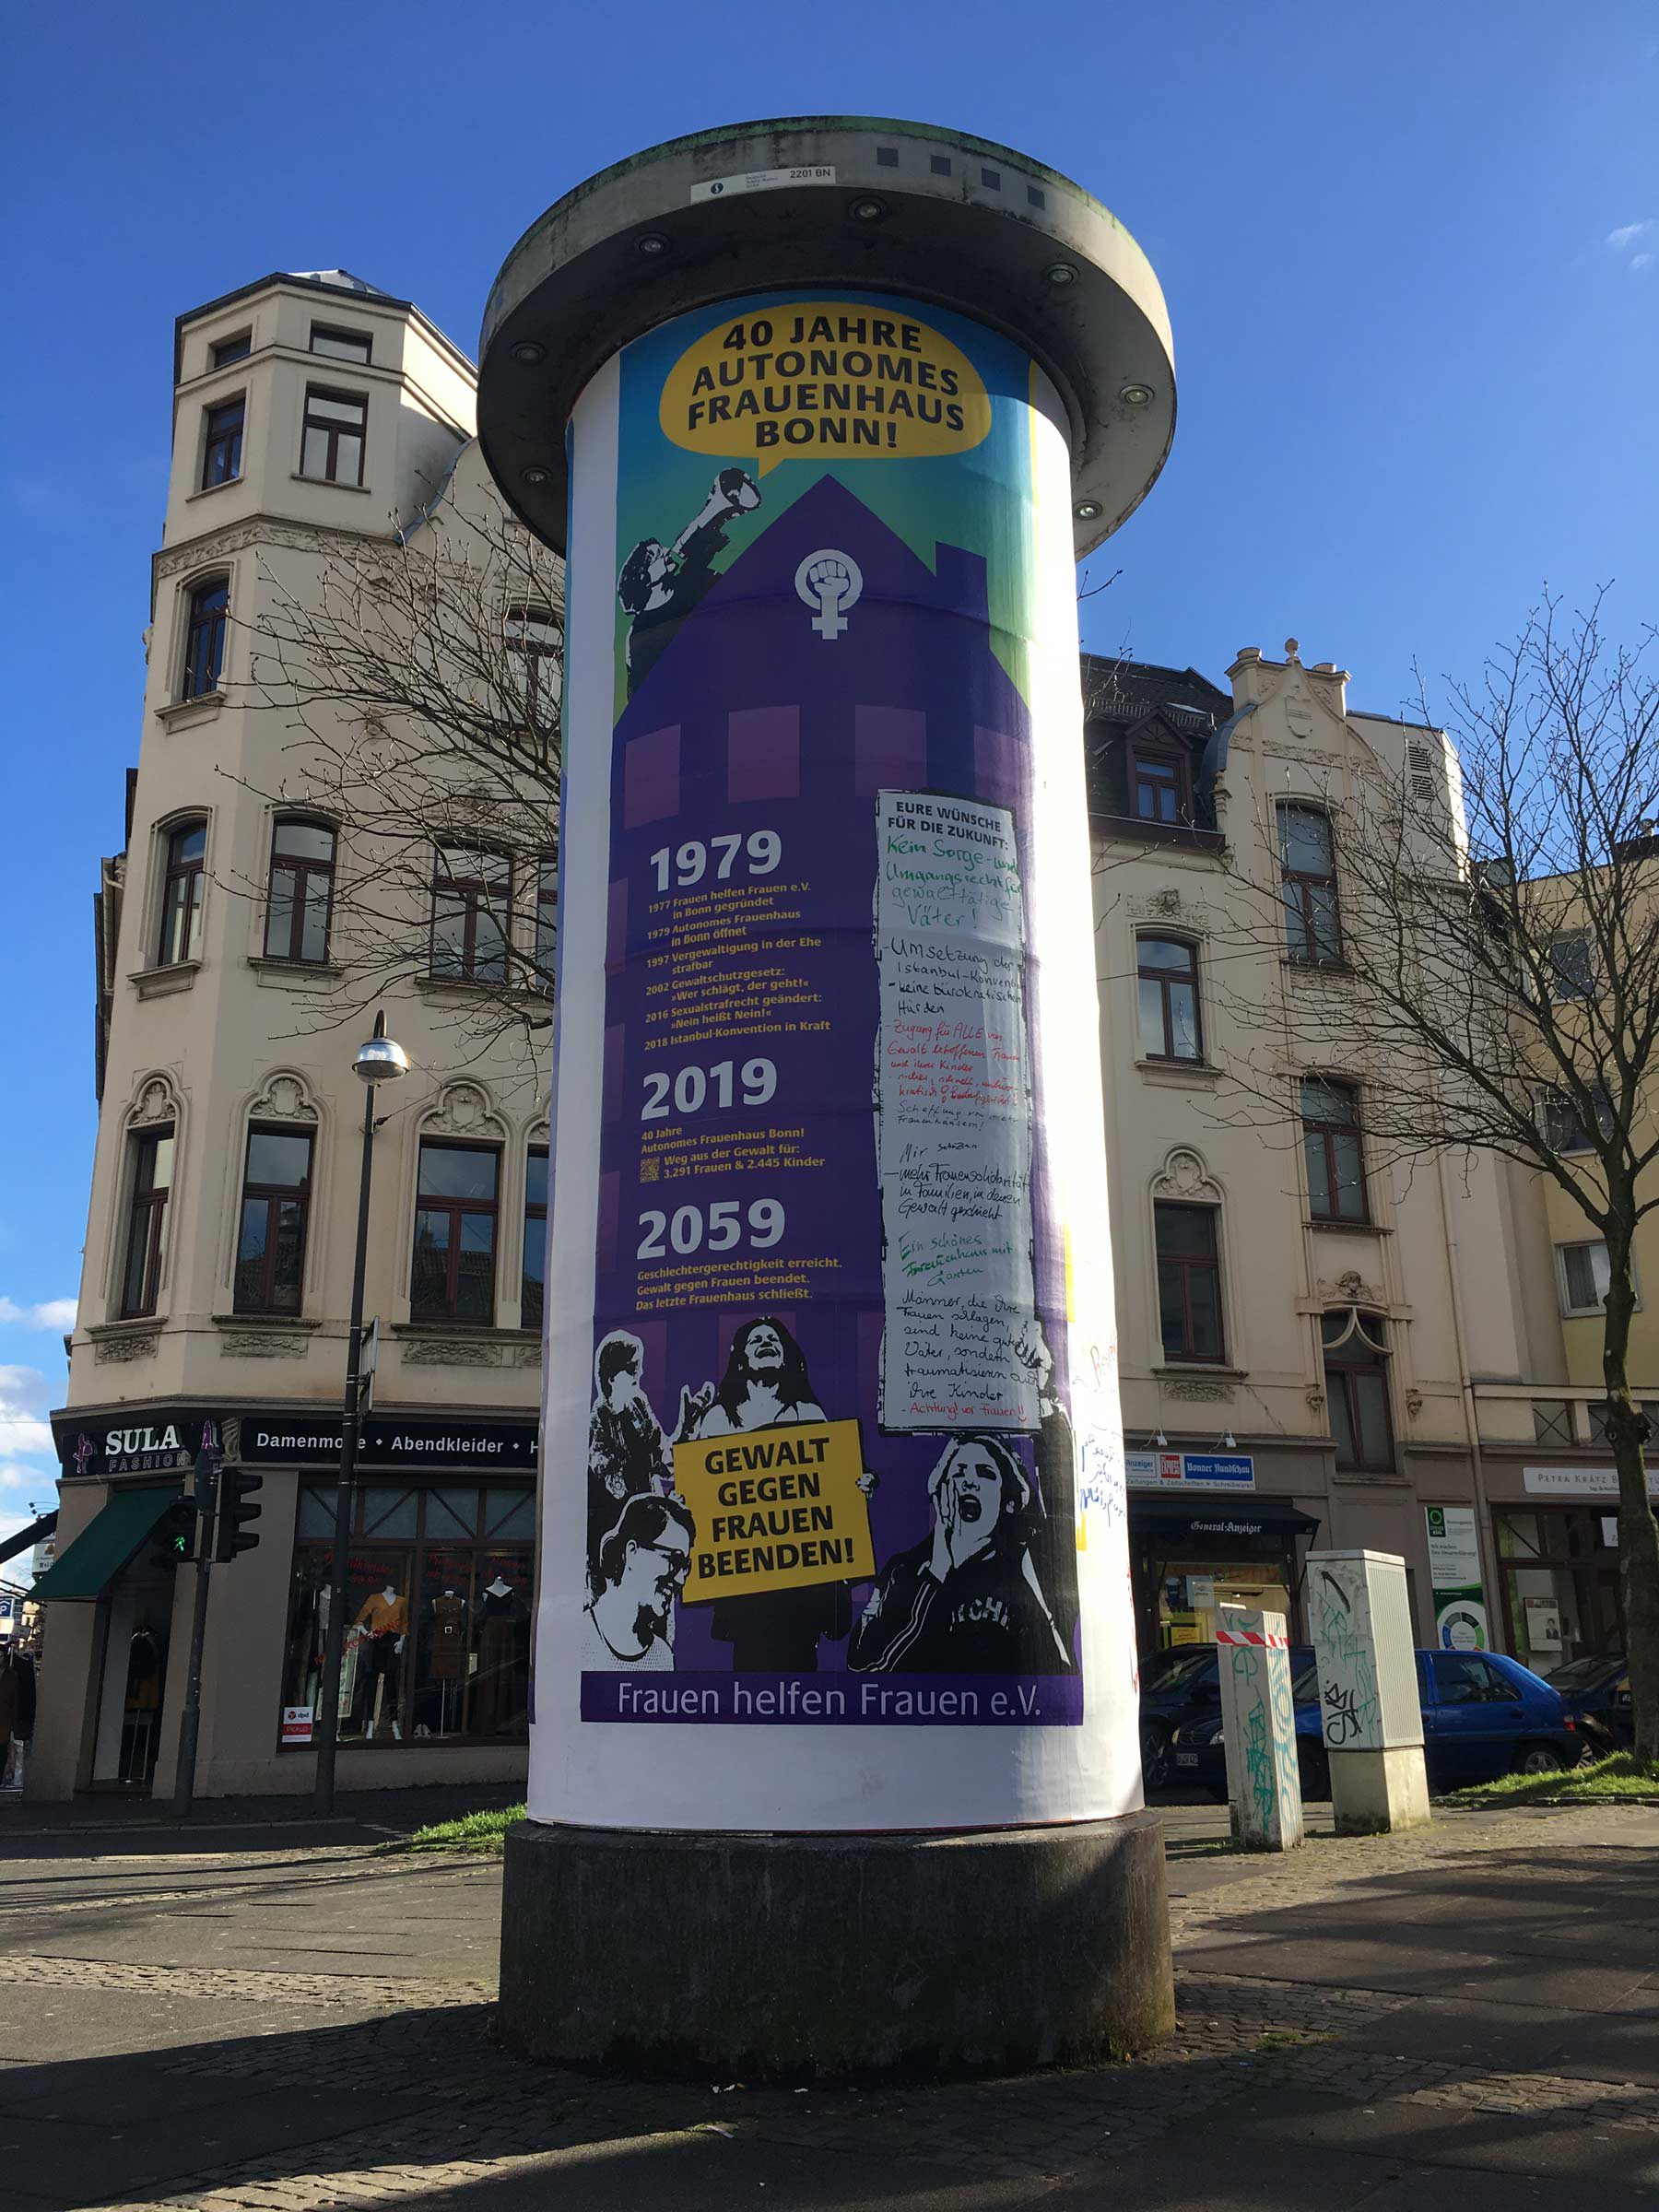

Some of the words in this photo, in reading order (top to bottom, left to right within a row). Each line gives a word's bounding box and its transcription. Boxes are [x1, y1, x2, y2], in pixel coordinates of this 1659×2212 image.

[790, 170, 812, 178] 2201
[816, 169, 830, 177] BN
[724, 320, 773, 350] 40
[790, 316, 922, 353] JAHRE
[691, 349, 959, 395] AUTONOMES
[688, 383, 964, 431] FRAUENHAUS
[756, 418, 897, 448] BONN!
[896, 802, 932, 817] EURE
[937, 806, 1001, 831] WÜNSCHE
[888, 816, 916, 830] FÜR
[922, 822, 944, 834] DIE
[947, 826, 1008, 850] ZUKUNFT:
[888, 834, 926, 854] Kein
[650, 830, 782, 892] 1979
[649, 900, 670, 913] 1977
[673, 895, 707, 907] Frauen
[711, 888, 745, 900] helfen
[748, 882, 786, 895] Frauen
[791, 882, 811, 892] e.V.
[673, 911, 682, 919] in
[686, 905, 711, 916] Bonn
[714, 897, 774, 913] gegründet
[648, 927, 670, 940] 1979
[673, 918, 731, 934] Autonomes
[735, 911, 801, 924] Frauenhaus
[671, 937, 680, 947] in
[684, 931, 710, 945] Bonn
[713, 926, 747, 939] öffnet
[647, 956, 669, 968] 1997
[673, 942, 758, 962] Vergewaltigung
[761, 940, 772, 949] in
[776, 938, 795, 947] der
[800, 937, 821, 947] Ehe
[672, 960, 712, 974] strafbar
[646, 982, 668, 995] 2002
[672, 968, 784, 990] Gewaltschutzgesetz:
[701, 981, 744, 996] schlägt,
[747, 980, 766, 991] der
[645, 1010, 668, 1023] 2016
[671, 996, 759, 1017] Sexualstrafrecht
[762, 994, 822, 1005] geändert:
[702, 1011, 731, 1023] heißt
[899, 999, 944, 1015] Hürden
[645, 1038, 667, 1050] 2018
[671, 1022, 781, 1044] Istanbul-Konvention
[785, 1021, 795, 1030] in
[800, 1021, 830, 1030] Kraft
[641, 1058, 777, 1121] 2019
[641, 1131, 653, 1140] 40
[656, 1126, 682, 1138] Jahre
[641, 1137, 697, 1154] Autonomes
[700, 1130, 765, 1144] Frauenhaus
[769, 1128, 805, 1138] Bonn!
[665, 1155, 688, 1168] Weg
[690, 1152, 708, 1161] aus
[712, 1148, 730, 1159] der
[734, 1145, 774, 1157] Gewalt
[779, 1145, 800, 1153] für:
[665, 1167, 691, 1179] 3.291
[695, 1162, 731, 1174] Frauen
[735, 1160, 744, 1170] &
[747, 1159, 780, 1169] 2.445
[783, 1157, 825, 1167] Kinder
[899, 1198, 947, 1219] Gewalt
[637, 1198, 785, 1260] 2059
[638, 1259, 783, 1281] Geschlechtergerechtigkeit
[788, 1258, 842, 1268] erreicht.
[638, 1282, 671, 1295] Gewalt
[675, 1278, 708, 1293] gegen
[712, 1276, 750, 1288] Frauen
[754, 1274, 809, 1284] beendet.
[636, 1300, 653, 1311] Das
[656, 1297, 686, 1308] letzte
[689, 1290, 755, 1304] Frauenhaus
[759, 1288, 812, 1300] schließt.
[897, 1307, 944, 1319] Frauen
[948, 1382, 1003, 1401] Kinder
[105, 1425, 180, 1456] SULA
[257, 1432, 366, 1449] Damenmoe
[391, 1436, 504, 1453] Abendkleider
[109, 1453, 186, 1472] FASHION
[704, 1437, 830, 1475] GEWALT
[717, 1472, 820, 1506] GEGEN
[712, 1505, 833, 1542] FRAUEN
[698, 1537, 855, 1579] BEENDEN!
[618, 1681, 720, 1715] Frauen
[733, 1681, 846, 1715] helfen
[860, 1685, 979, 1717] Frauen
[990, 1685, 1041, 1718] e.V.
